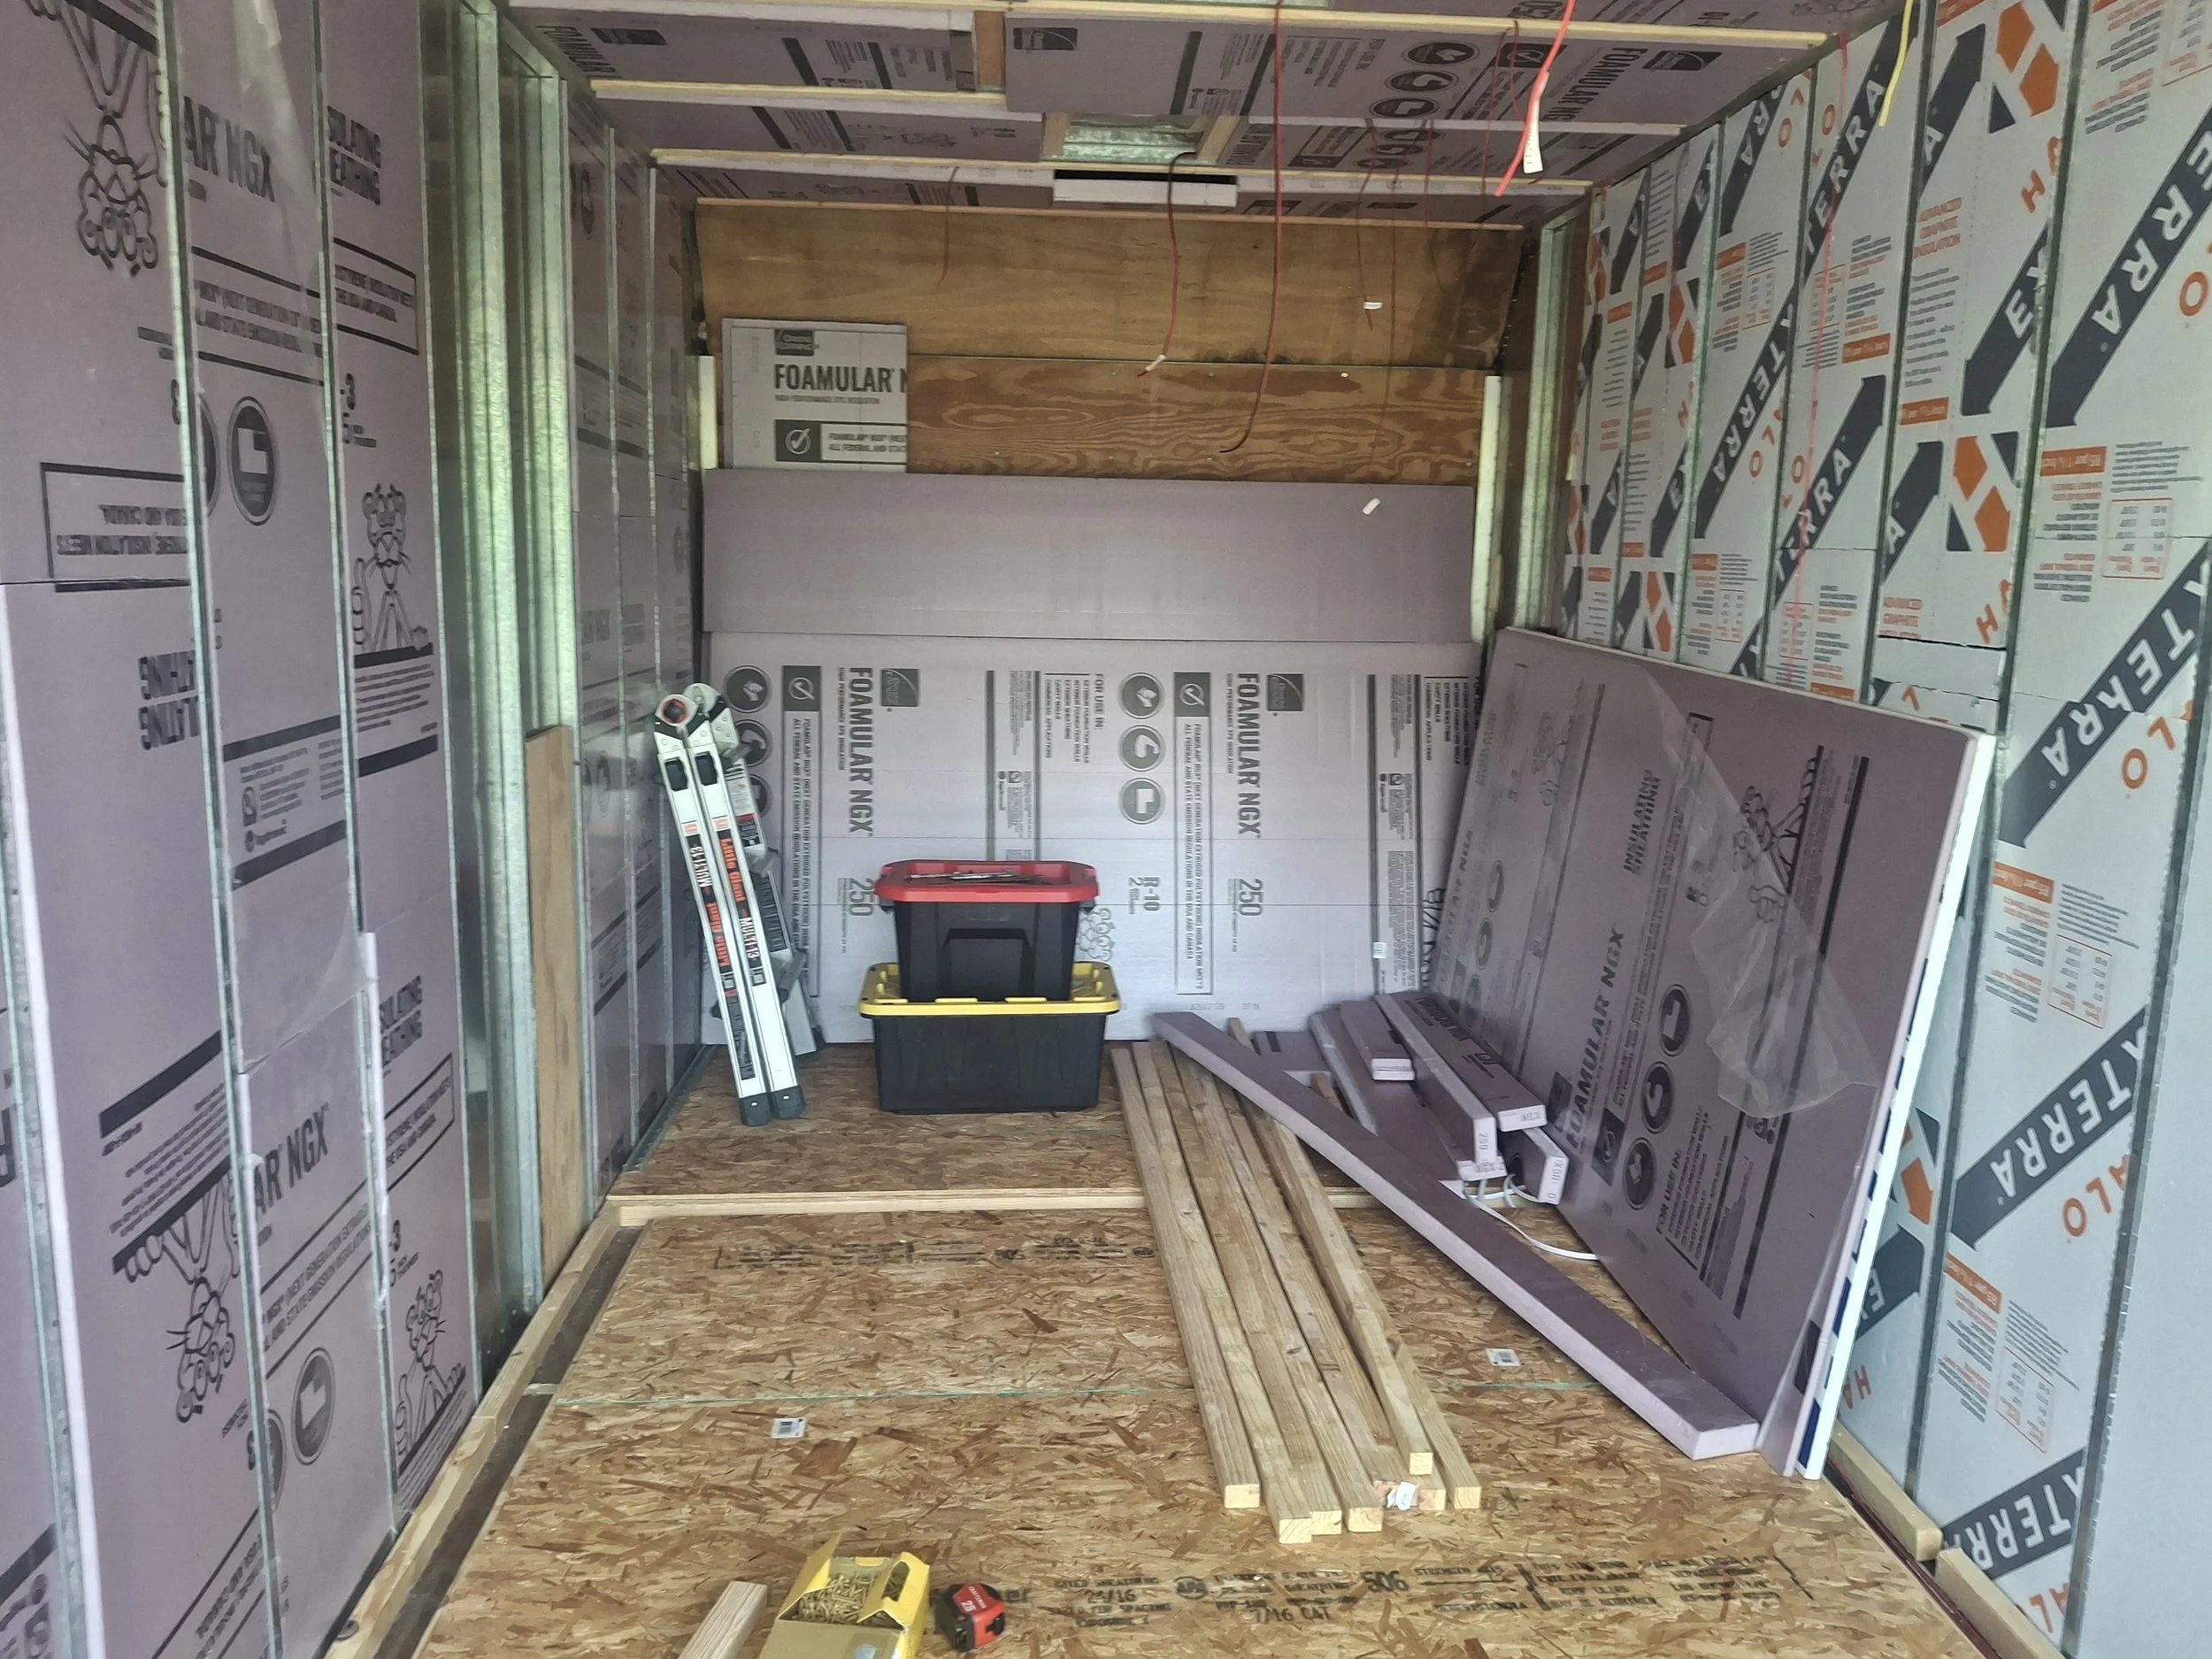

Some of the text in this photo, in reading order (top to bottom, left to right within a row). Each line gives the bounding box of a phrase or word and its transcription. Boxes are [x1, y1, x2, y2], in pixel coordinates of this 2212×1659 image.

[1543, 47, 1648, 122] FOAMULAR NG
[2092, 131, 2212, 335] ERRA
[774, 364, 892, 392] FOAMULAR
[1094, 673, 1104, 693] FOR
[1094, 695, 1104, 715] USE
[2041, 608, 2195, 778] TERRA
[849, 667, 873, 833] FOAMULAR NGX
[1238, 673, 1261, 835] FOAMULAR NGX
[720, 838, 736, 869] Little
[728, 871, 746, 902] Giant
[1144, 877, 1160, 911] R-10
[707, 902, 723, 933] Giant
[849, 878, 874, 916] 250
[1239, 879, 1263, 916] 250
[715, 935, 732, 967] Little
[1566, 926, 1625, 1149] FOAMULAR NGX
[287, 1103, 329, 1188] NGX
[1989, 1058, 2134, 1199] TERRA
[1360, 1571, 1409, 1593] 506
